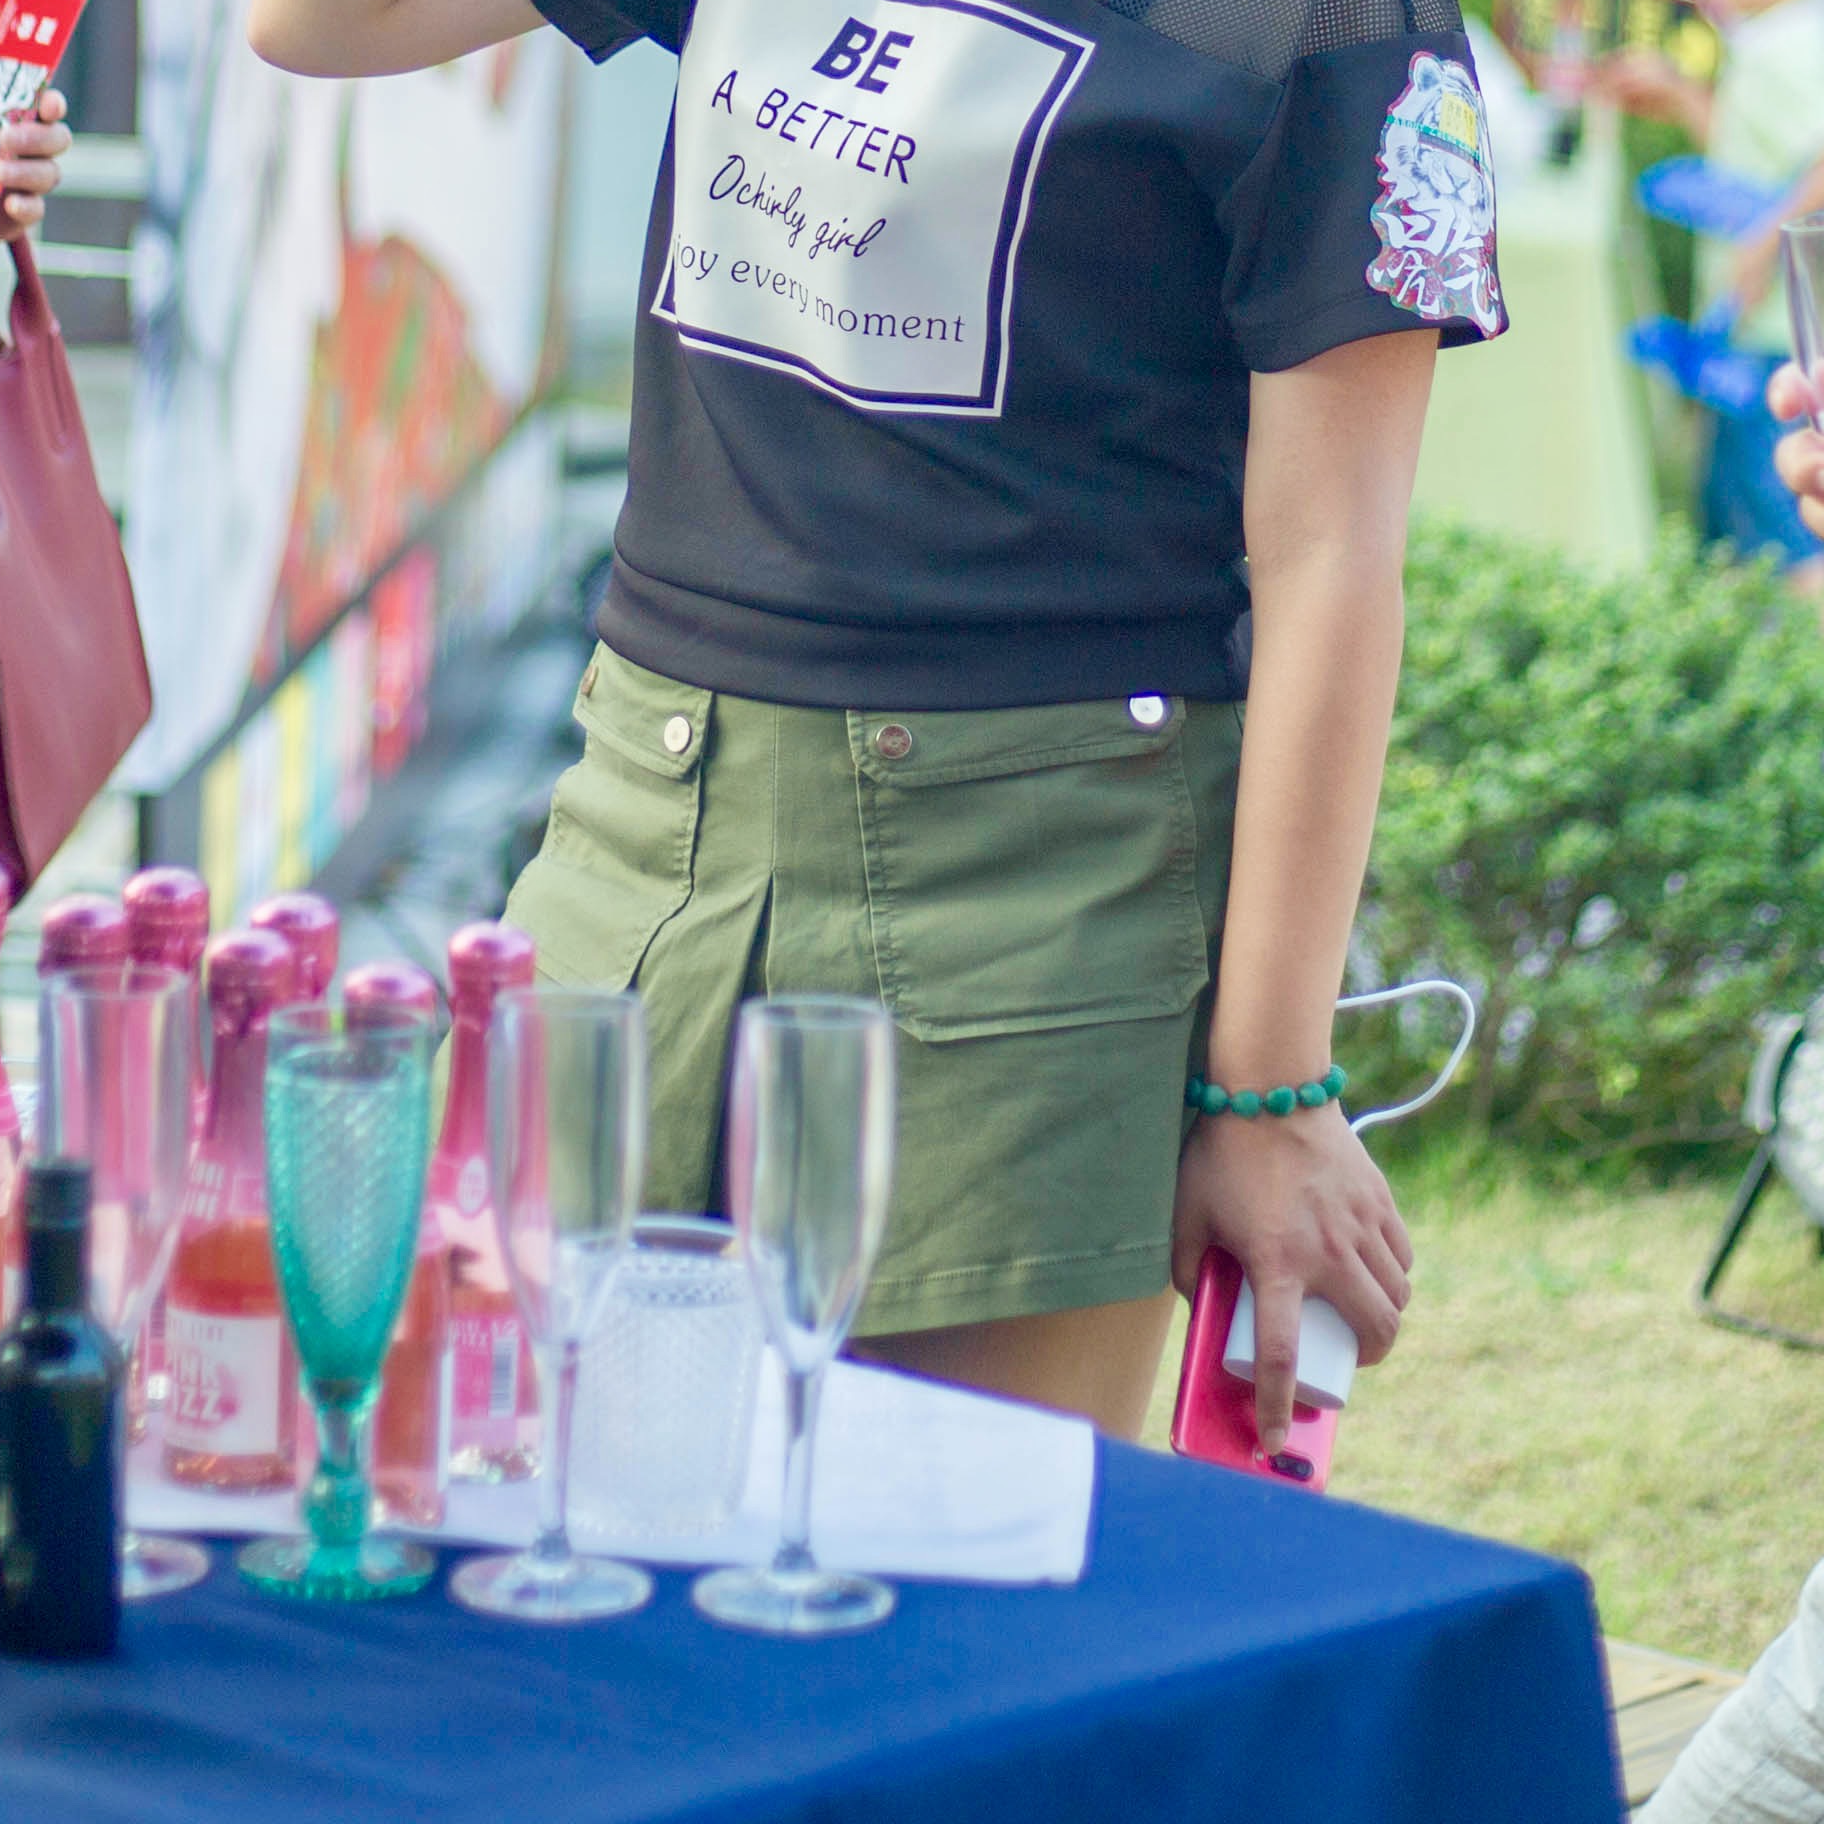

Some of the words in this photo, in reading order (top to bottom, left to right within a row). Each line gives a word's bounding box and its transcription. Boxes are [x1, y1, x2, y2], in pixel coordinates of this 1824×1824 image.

[811, 16, 916, 95] BE
[711, 69, 739, 115] A
[755, 87, 917, 184] BETTER
[708, 153, 808, 249] Ochirly
[808, 217, 887, 260] girl
[731, 259, 809, 313] every
[814, 294, 966, 343] moment
